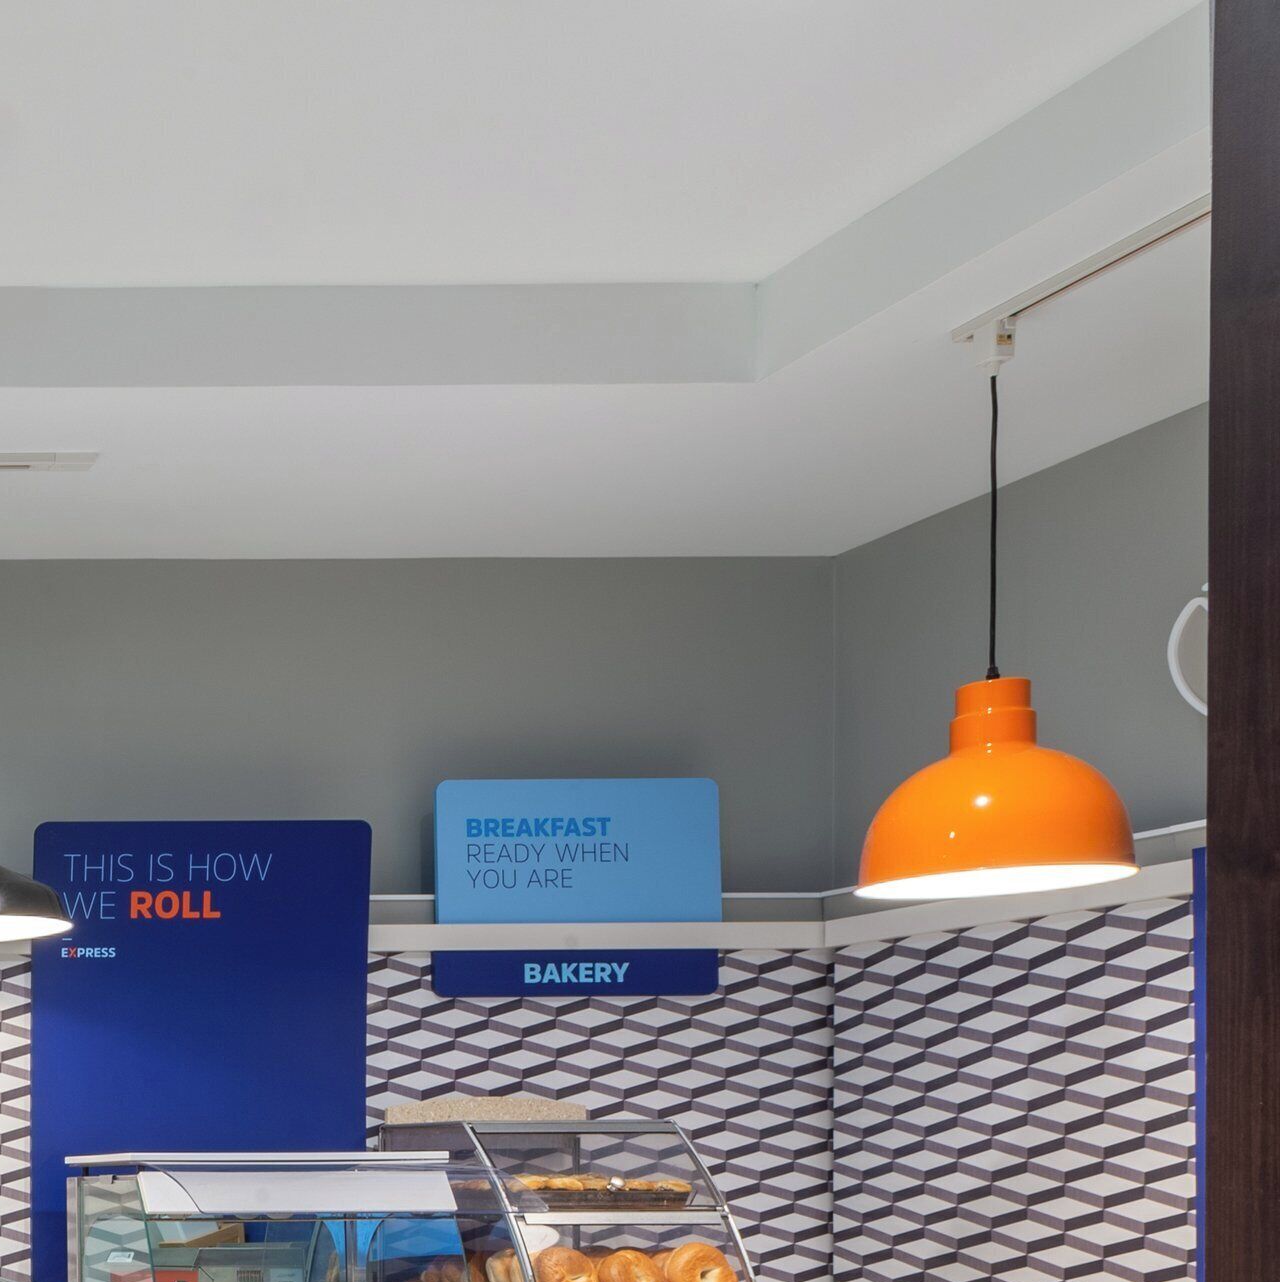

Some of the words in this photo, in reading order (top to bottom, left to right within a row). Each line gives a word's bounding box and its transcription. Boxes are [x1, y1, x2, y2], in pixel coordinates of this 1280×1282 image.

[466, 817, 611, 838] BREAKFAST
[466, 843, 546, 864] READY
[555, 842, 630, 863] WHEN
[63, 853, 135, 882] THIS
[148, 853, 175, 882] IS
[189, 852, 273, 882] HOW
[466, 868, 517, 889] YOU
[527, 868, 574, 889] ARE
[63, 890, 116, 920] WE
[129, 889, 221, 920] ROLL
[61, 947, 116, 958] EXPRESS
[524, 962, 630, 984] BAKERY
